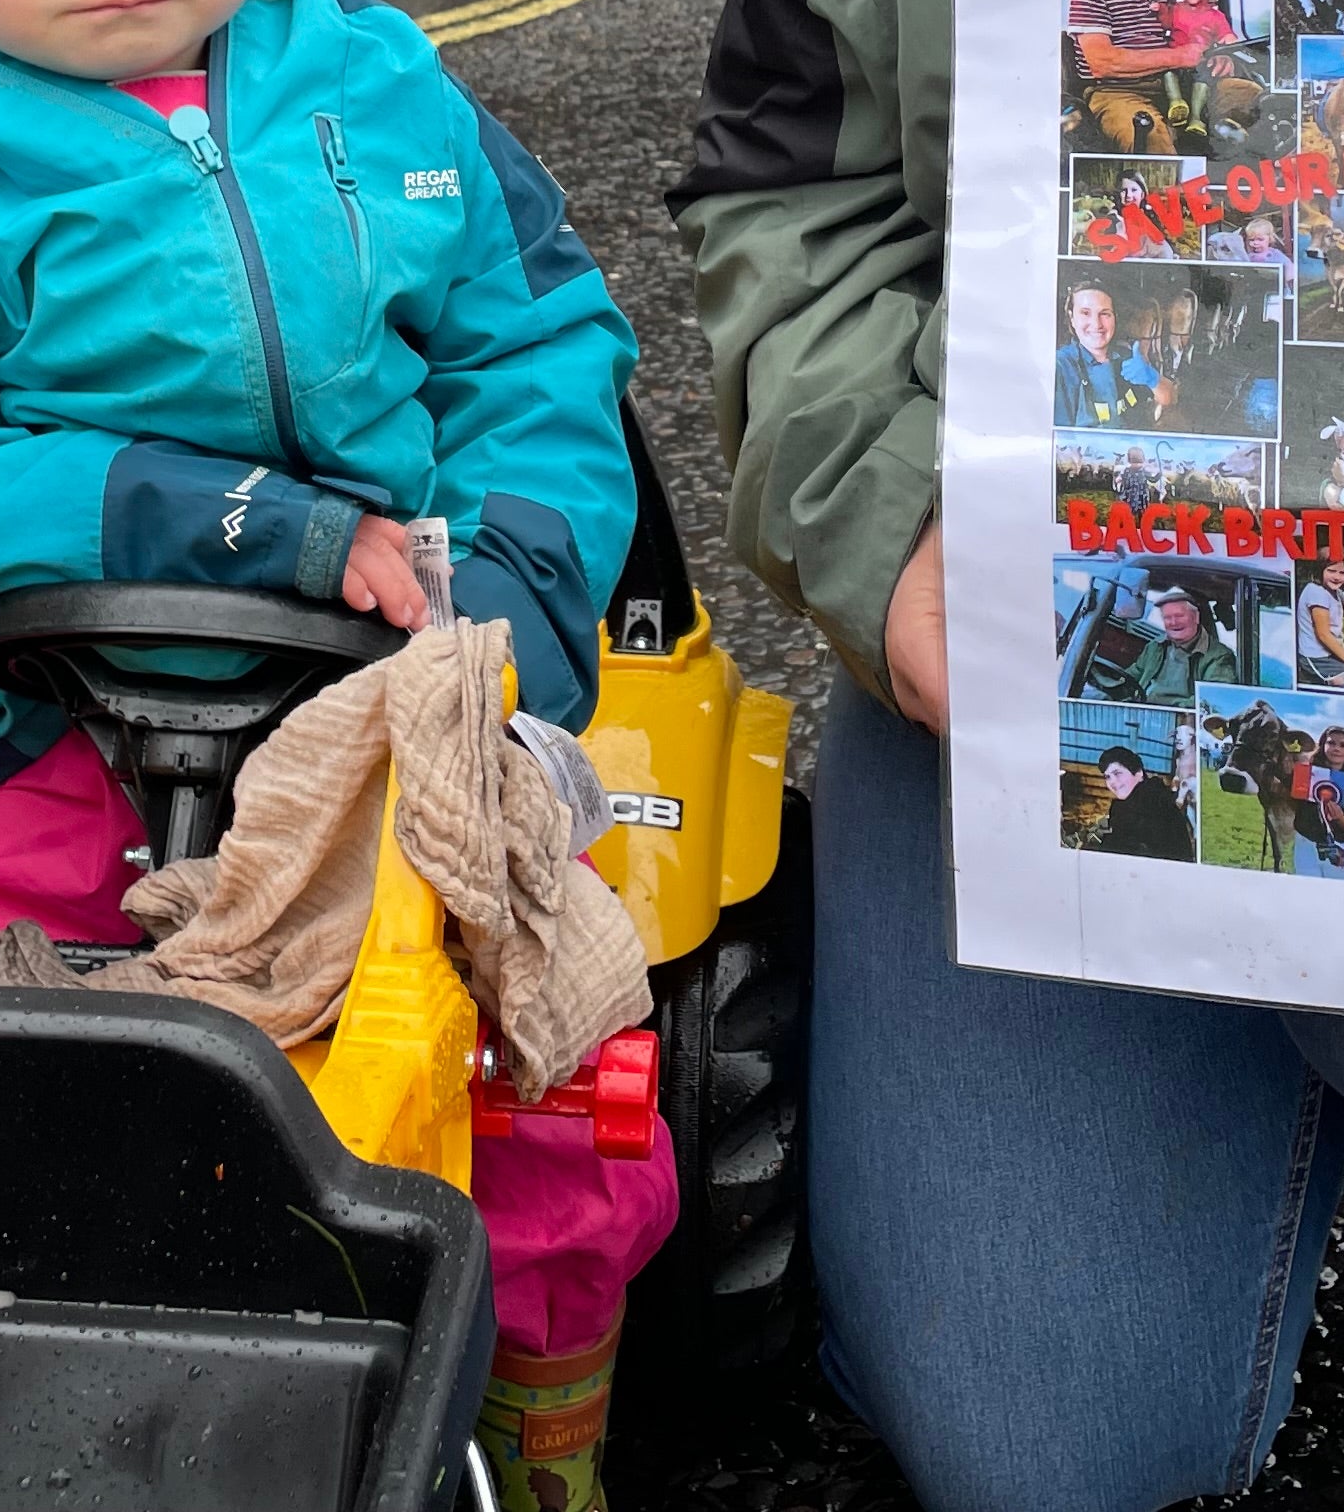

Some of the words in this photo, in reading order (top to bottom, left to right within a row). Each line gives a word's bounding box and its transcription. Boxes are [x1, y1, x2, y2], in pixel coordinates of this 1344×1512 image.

[405, 185, 444, 200] GREAT
[1087, 175, 1224, 263] SAVE
[1226, 151, 1337, 213] OUR
[1067, 498, 1213, 555] BACK
[608, 793, 680, 828] CB
